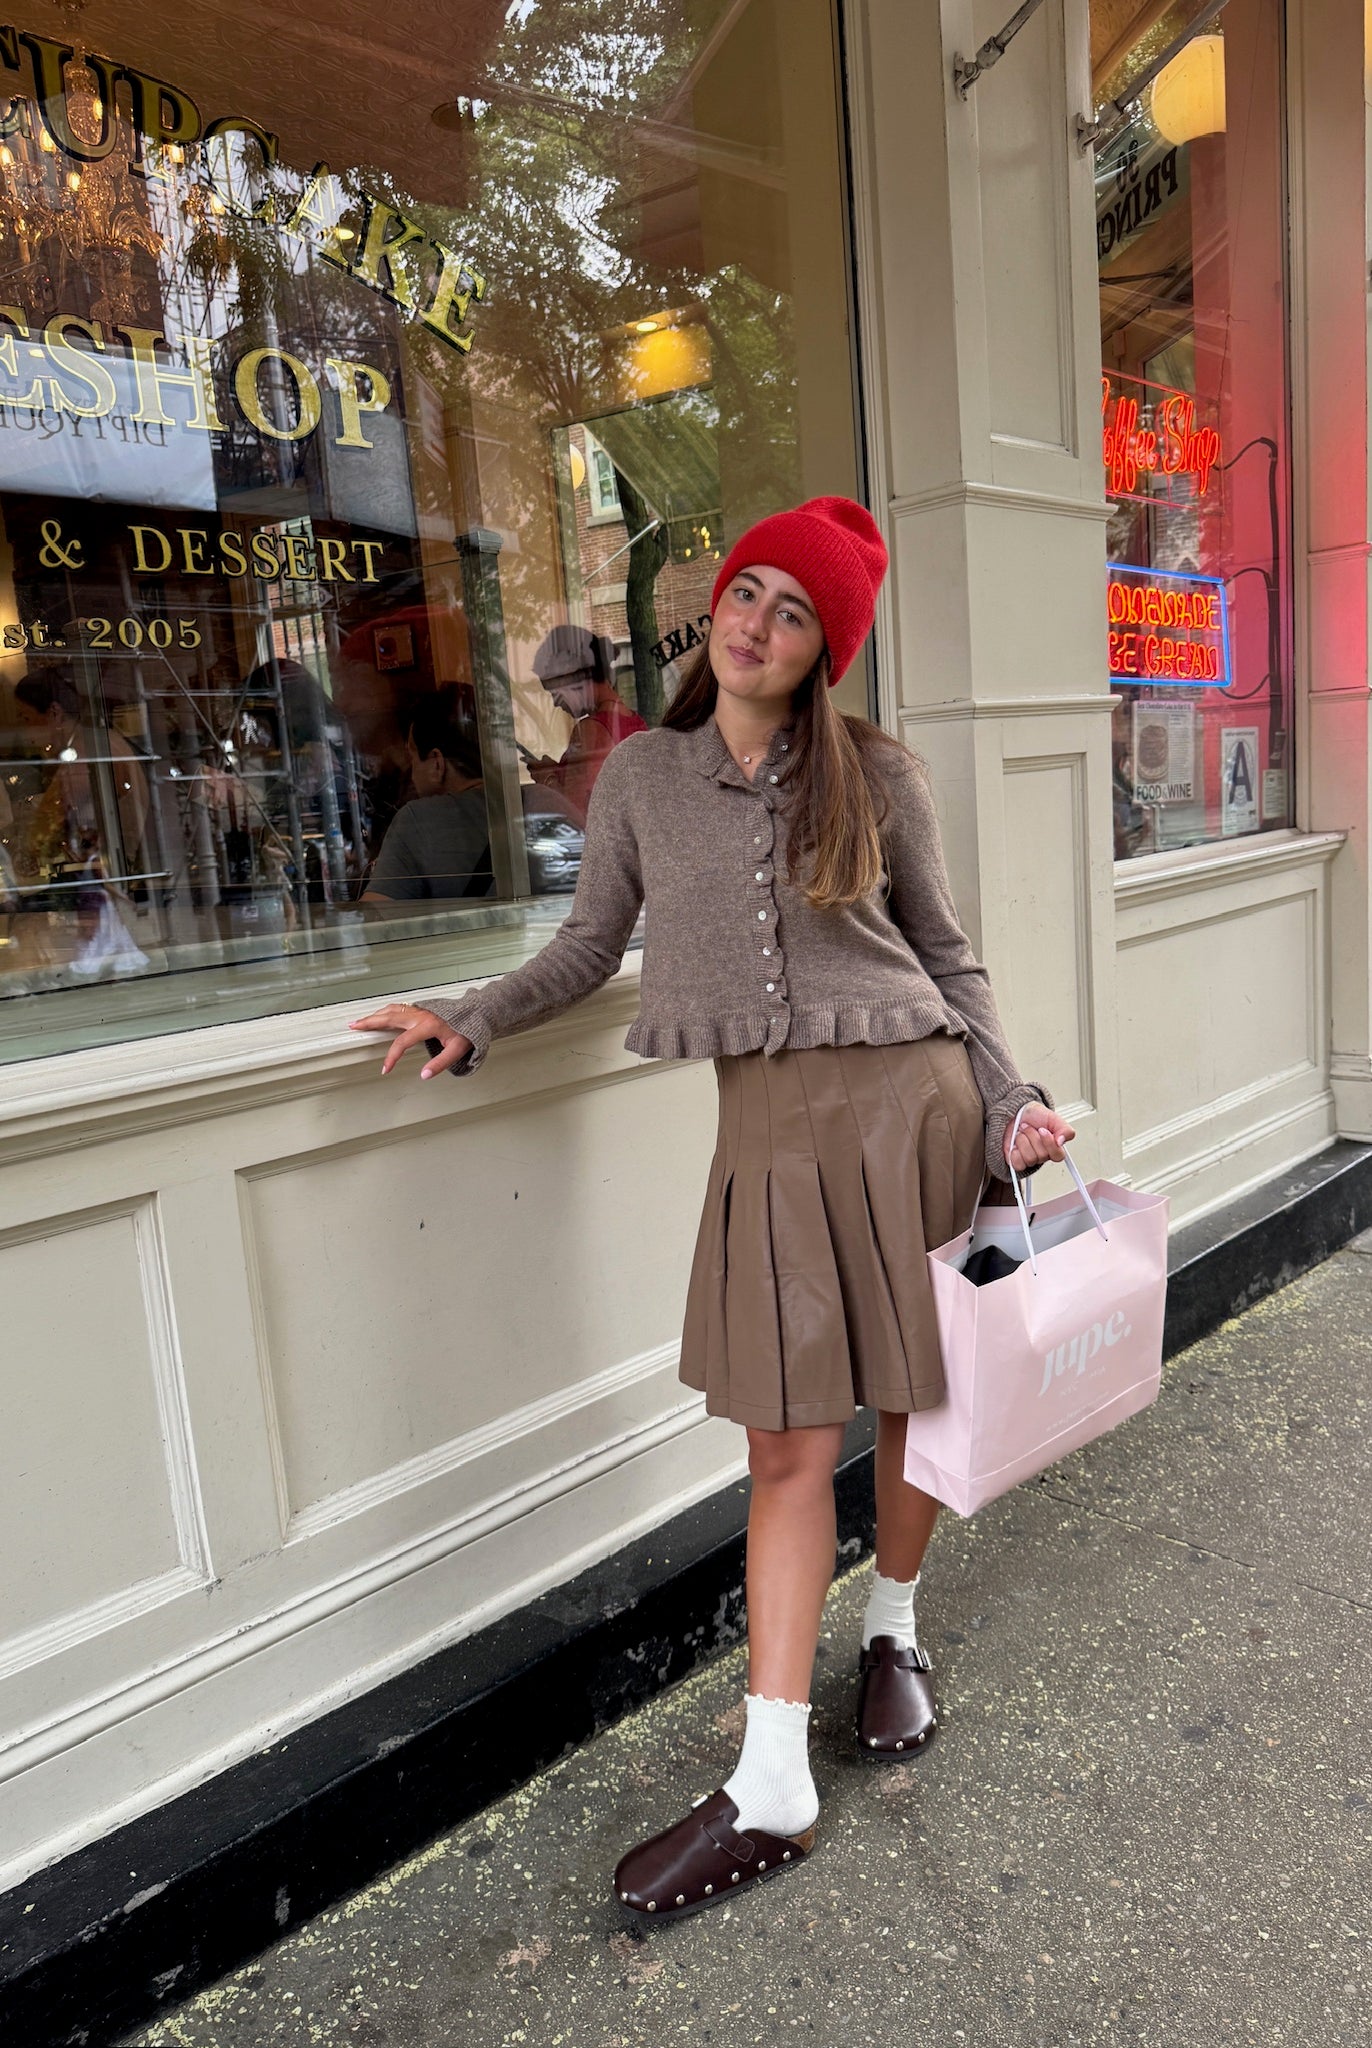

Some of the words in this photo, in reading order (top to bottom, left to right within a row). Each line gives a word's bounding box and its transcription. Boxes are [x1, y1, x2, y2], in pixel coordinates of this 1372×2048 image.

[1101, 377, 1159, 493] offee
[1162, 395, 1219, 496] Shop
[38, 519, 85, 570] &
[126, 524, 385, 584] DESSERT
[86, 617, 202, 649] 2005
[1144, 634, 1219, 681] CREAM
[1229, 741, 1253, 804] A
